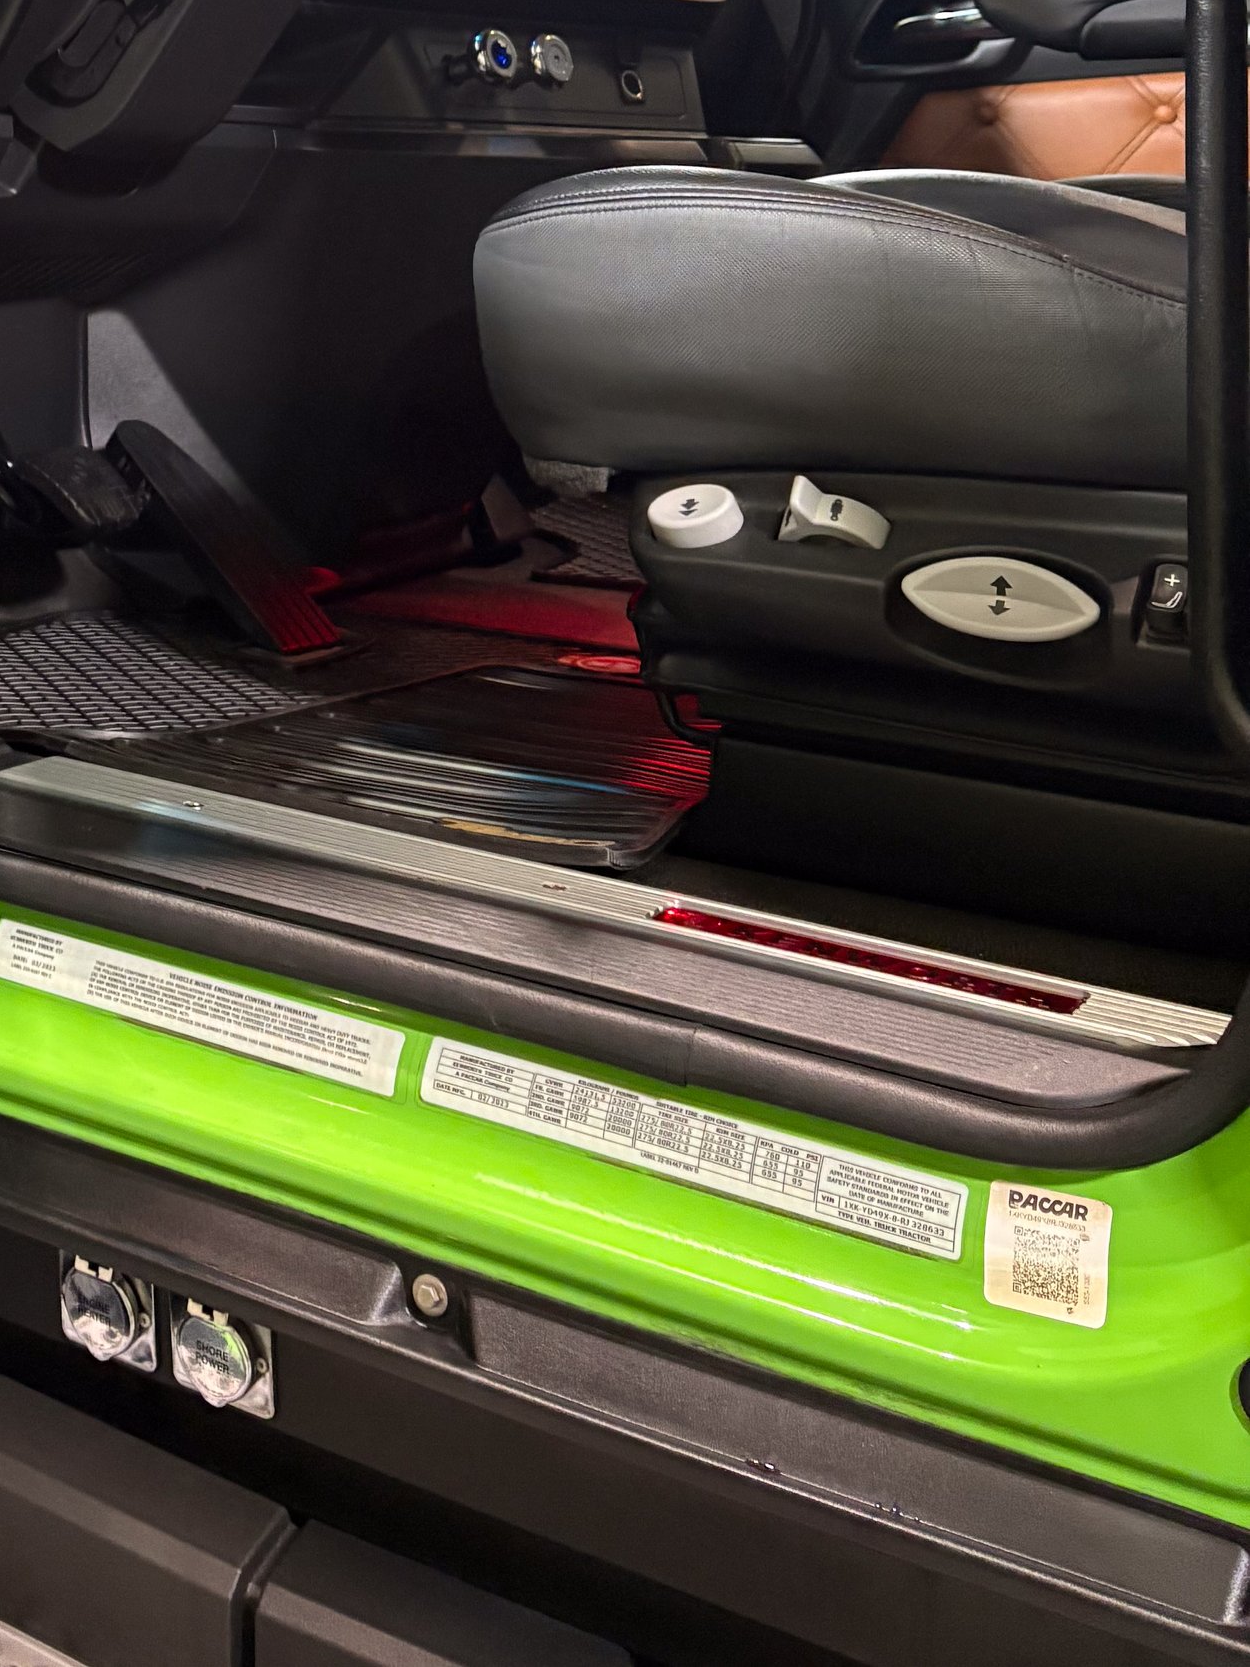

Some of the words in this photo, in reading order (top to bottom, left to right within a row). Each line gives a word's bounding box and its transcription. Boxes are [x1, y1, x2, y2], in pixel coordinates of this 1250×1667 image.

[169, 973, 193, 984] VEHICLE
[245, 995, 272, 1007] CONTROL
[460, 1055, 505, 1072] MANUFACTURED
[436, 1082, 451, 1091] DATE
[484, 1080, 510, 1092] Company
[571, 1104, 590, 1114] 9072
[612, 1098, 636, 1109] 53200
[569, 1112, 588, 1123] 9072
[611, 1106, 634, 1118] 13200
[608, 1114, 632, 1126] 20000
[606, 1123, 631, 1135] 20000
[657, 1138, 689, 1153] 80R22.5
[705, 1133, 745, 1150] 22.5X8.25
[760, 1141, 774, 1149] KPA
[781, 1147, 799, 1156] COLD
[640, 1152, 655, 1161] LABEL
[703, 1142, 744, 1160] 22.5X8.25
[766, 1151, 780, 1160] 760
[702, 1151, 742, 1169] 22.5X8.25
[763, 1160, 779, 1170] 655
[796, 1160, 811, 1169] 110
[761, 1169, 777, 1179] 655
[793, 1169, 804, 1177] 95
[792, 1178, 802, 1187] 95
[839, 1164, 854, 1173] THIS
[855, 1169, 881, 1181] VEHICLE
[883, 1177, 918, 1192] CONFORMS
[921, 1187, 929, 1195] TO
[930, 1190, 942, 1198] ALL
[827, 1176, 851, 1188] SAFETY
[851, 1183, 889, 1199] STANDARDS
[900, 1198, 923, 1209] EFFECT
[937, 1208, 949, 1216] THE
[829, 1170, 866, 1185] APPLICABLE
[868, 1180, 894, 1193] FEDERAL
[897, 1189, 920, 1200] MOTOR
[921, 1196, 949, 1209] VEHICLE
[849, 1190, 865, 1200] DATE
[877, 1199, 924, 1218] MANUFACTURE
[1008, 1189, 1088, 1222] PACCAR
[821, 1195, 835, 1203] VIN
[911, 1221, 945, 1237] 328633
[837, 1211, 853, 1220] TYPE
[874, 1222, 896, 1233] TRUCK
[899, 1229, 931, 1243] TRACTOR
[196, 1340, 229, 1363] SHORE
[195, 1351, 230, 1374] POWER
